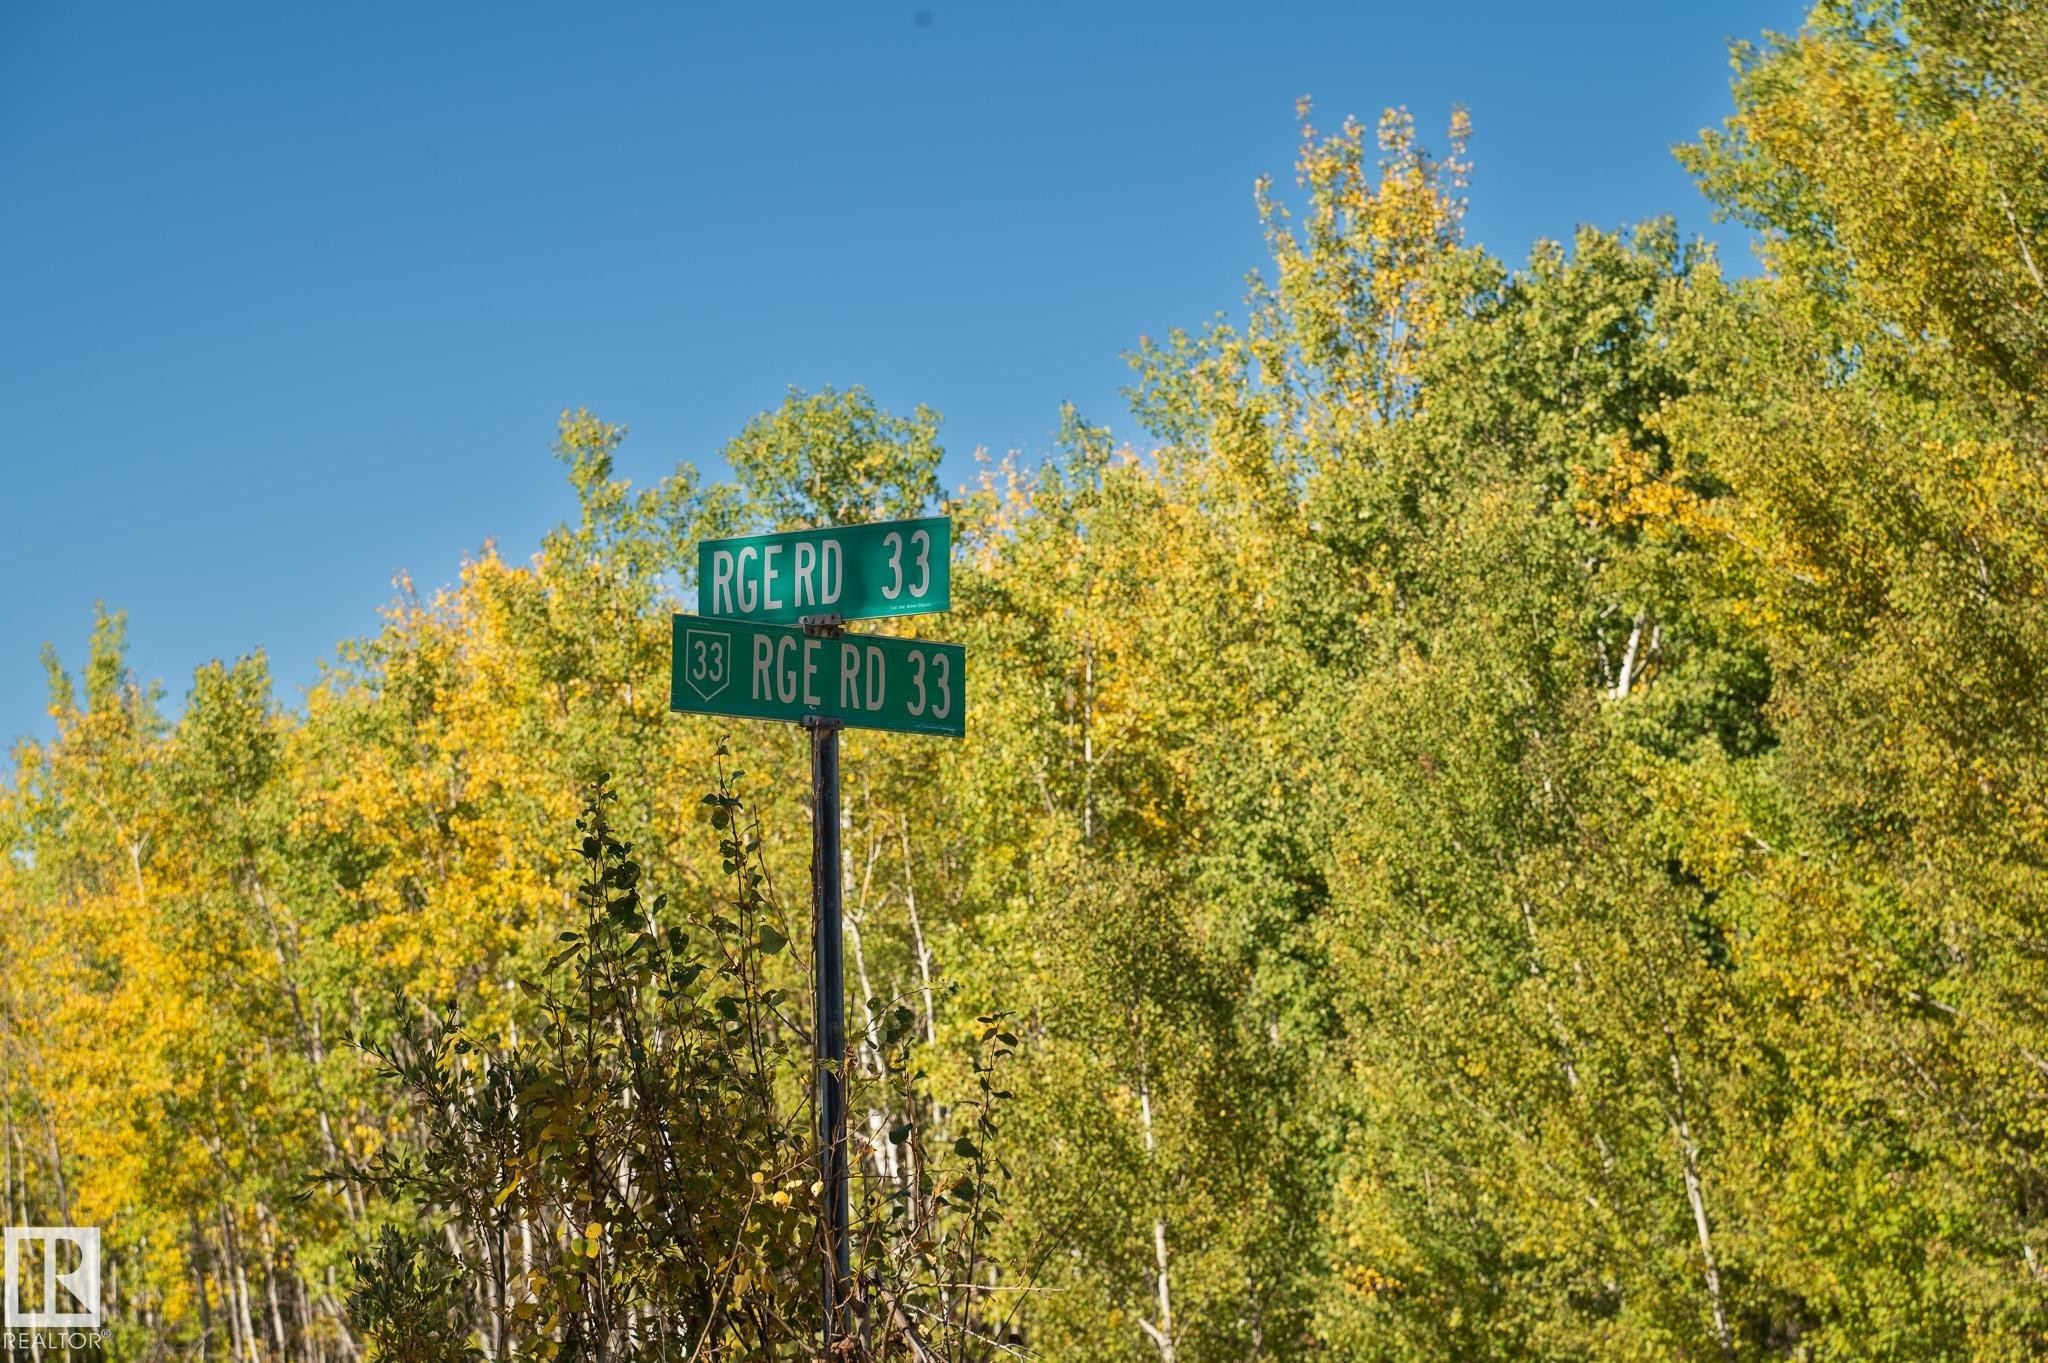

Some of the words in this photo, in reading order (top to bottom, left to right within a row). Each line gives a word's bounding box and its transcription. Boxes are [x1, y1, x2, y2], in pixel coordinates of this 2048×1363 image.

[713, 545, 783, 615] RGE
[794, 539, 842, 607] RD
[881, 530, 930, 599] 33
[693, 640, 723, 681] 33
[752, 633, 822, 705] RGE
[840, 643, 886, 711] RD
[907, 650, 950, 719] 33
